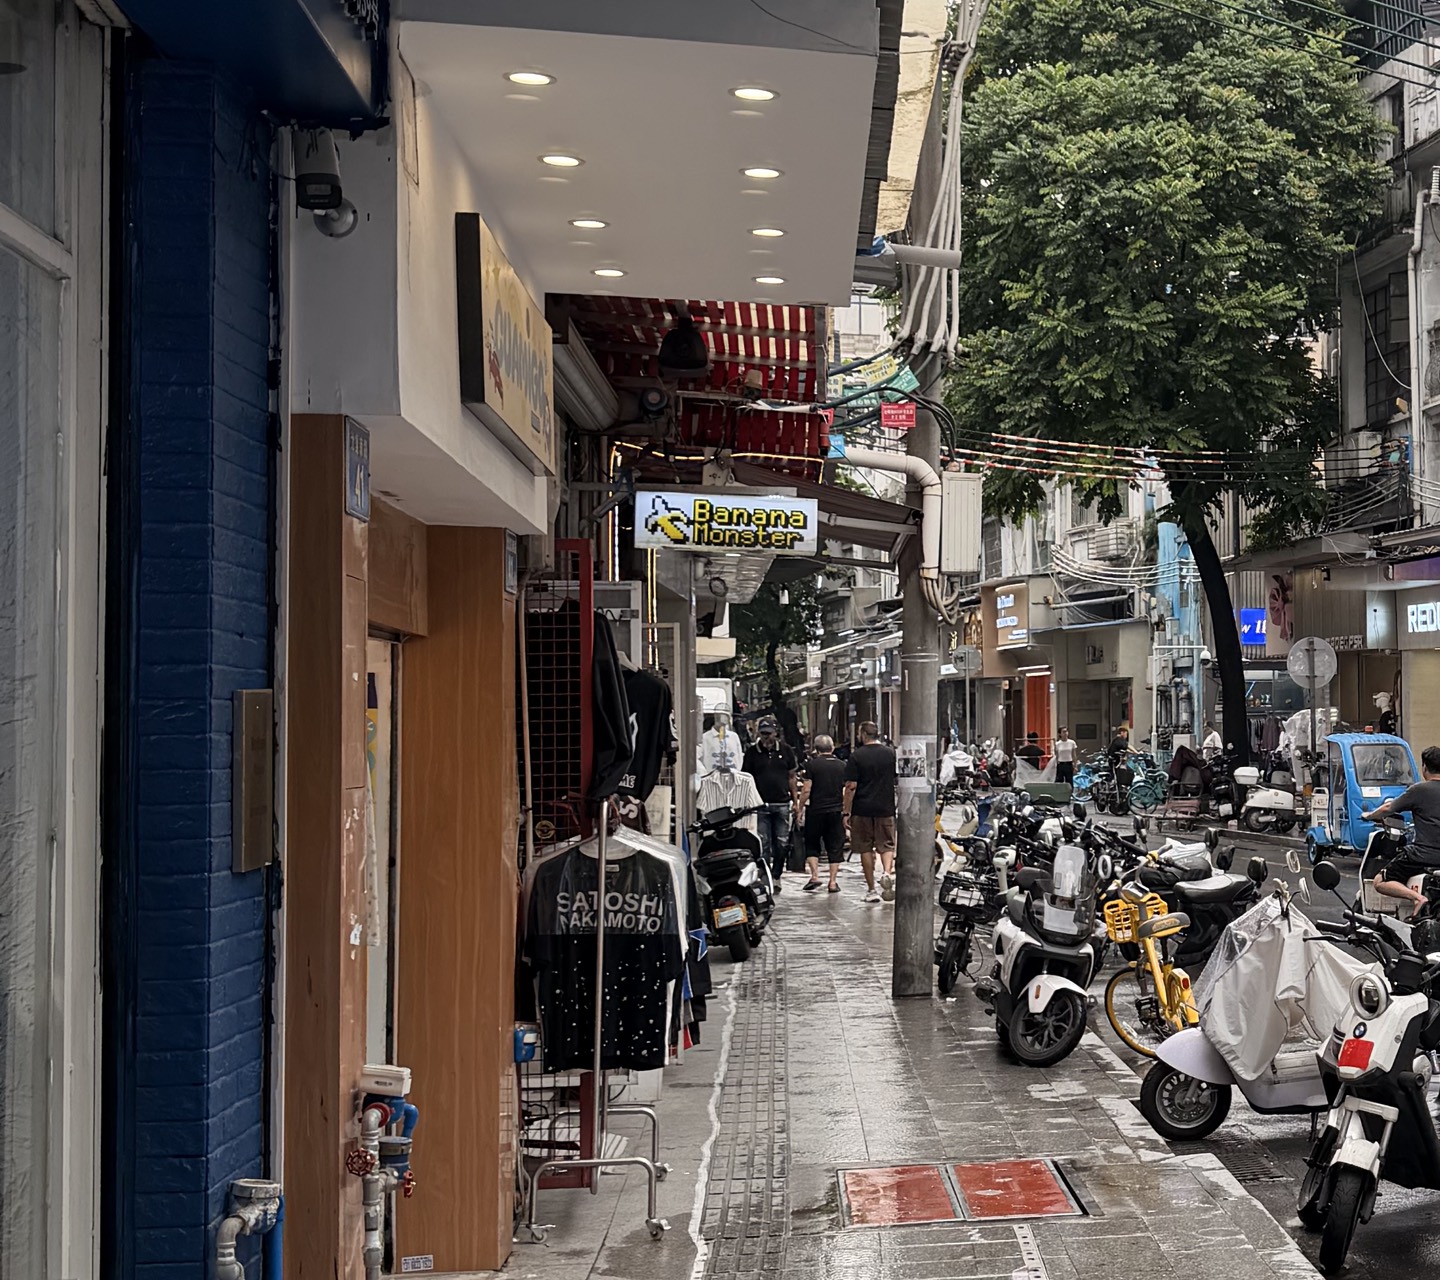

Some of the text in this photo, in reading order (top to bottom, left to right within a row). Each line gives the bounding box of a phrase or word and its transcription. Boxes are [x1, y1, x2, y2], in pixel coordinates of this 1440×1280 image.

[693, 499, 808, 530] Banana
[693, 522, 805, 549] Monster
[556, 890, 664, 916] SATOSHI
